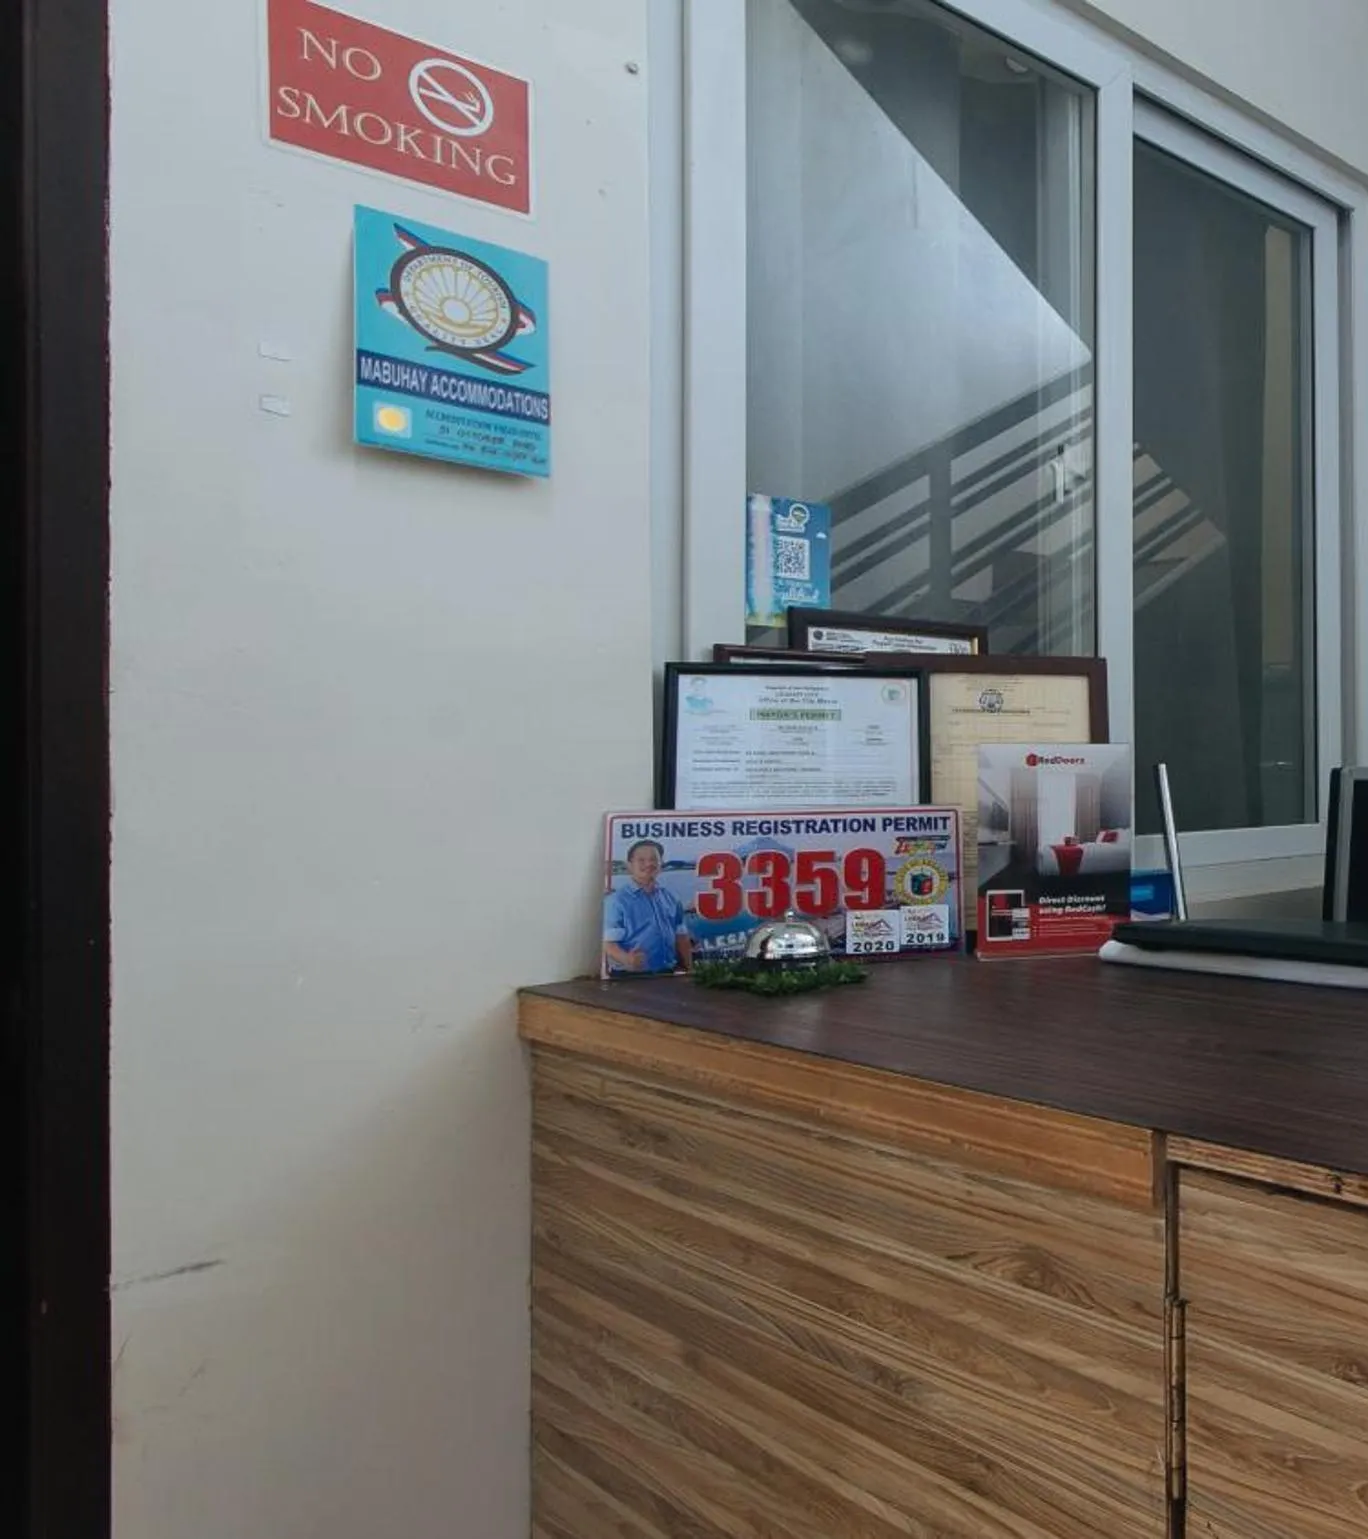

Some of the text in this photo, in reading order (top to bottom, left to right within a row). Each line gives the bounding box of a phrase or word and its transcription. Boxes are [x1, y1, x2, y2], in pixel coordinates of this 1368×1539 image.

[298, 27, 381, 81] NO
[277, 86, 516, 185] SMOKING
[360, 357, 548, 420] MABUHAY ACCOMMODATIONS
[621, 815, 951, 839] BUSINESS REGISTRATION PERMIT
[697, 848, 887, 920] 3359
[853, 940, 895, 953] 2020
